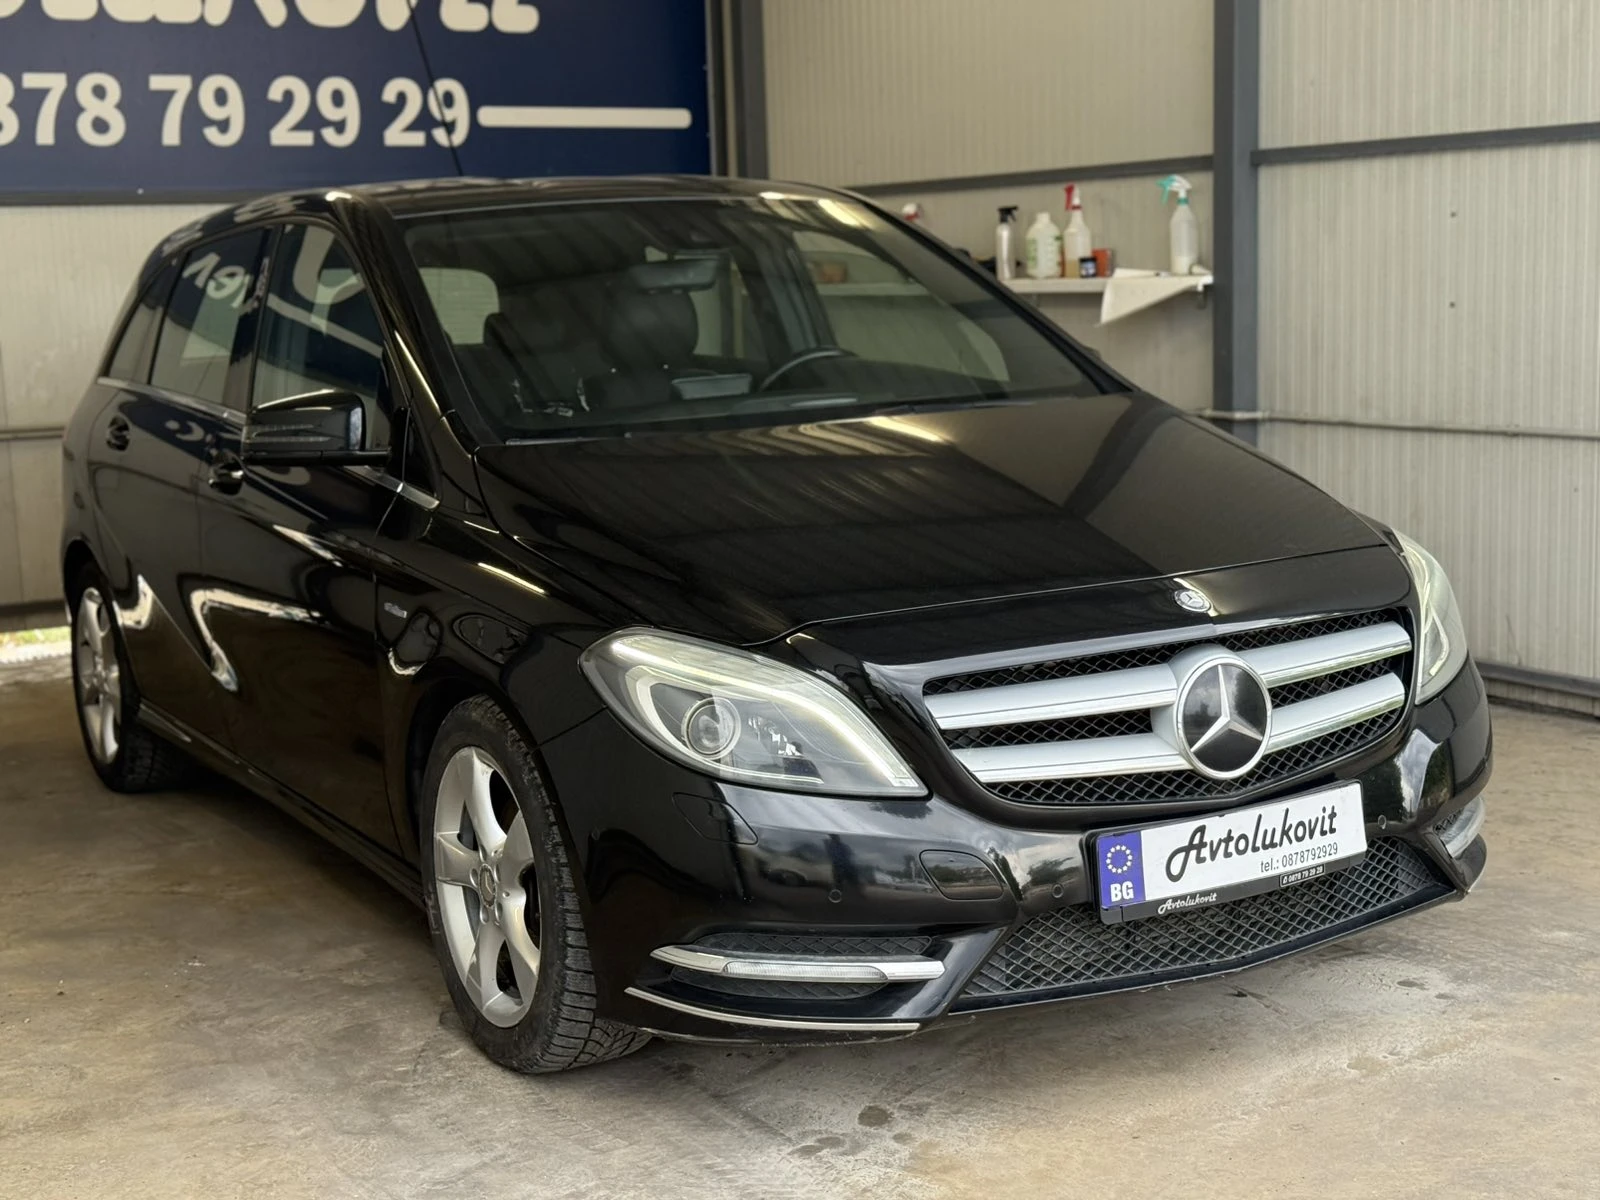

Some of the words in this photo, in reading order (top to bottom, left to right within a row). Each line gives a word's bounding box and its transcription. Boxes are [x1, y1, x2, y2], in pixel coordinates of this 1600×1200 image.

[148, 74, 246, 147] 79
[266, 75, 362, 148] 29
[381, 77, 471, 148] 29
[1165, 805, 1338, 883] Avtolukovit
[1260, 859, 1280, 873] tel.:
[1281, 842, 1339, 869] 0878792929
[1110, 881, 1134, 902] BG
[1157, 892, 1218, 915] Avtolukovit
